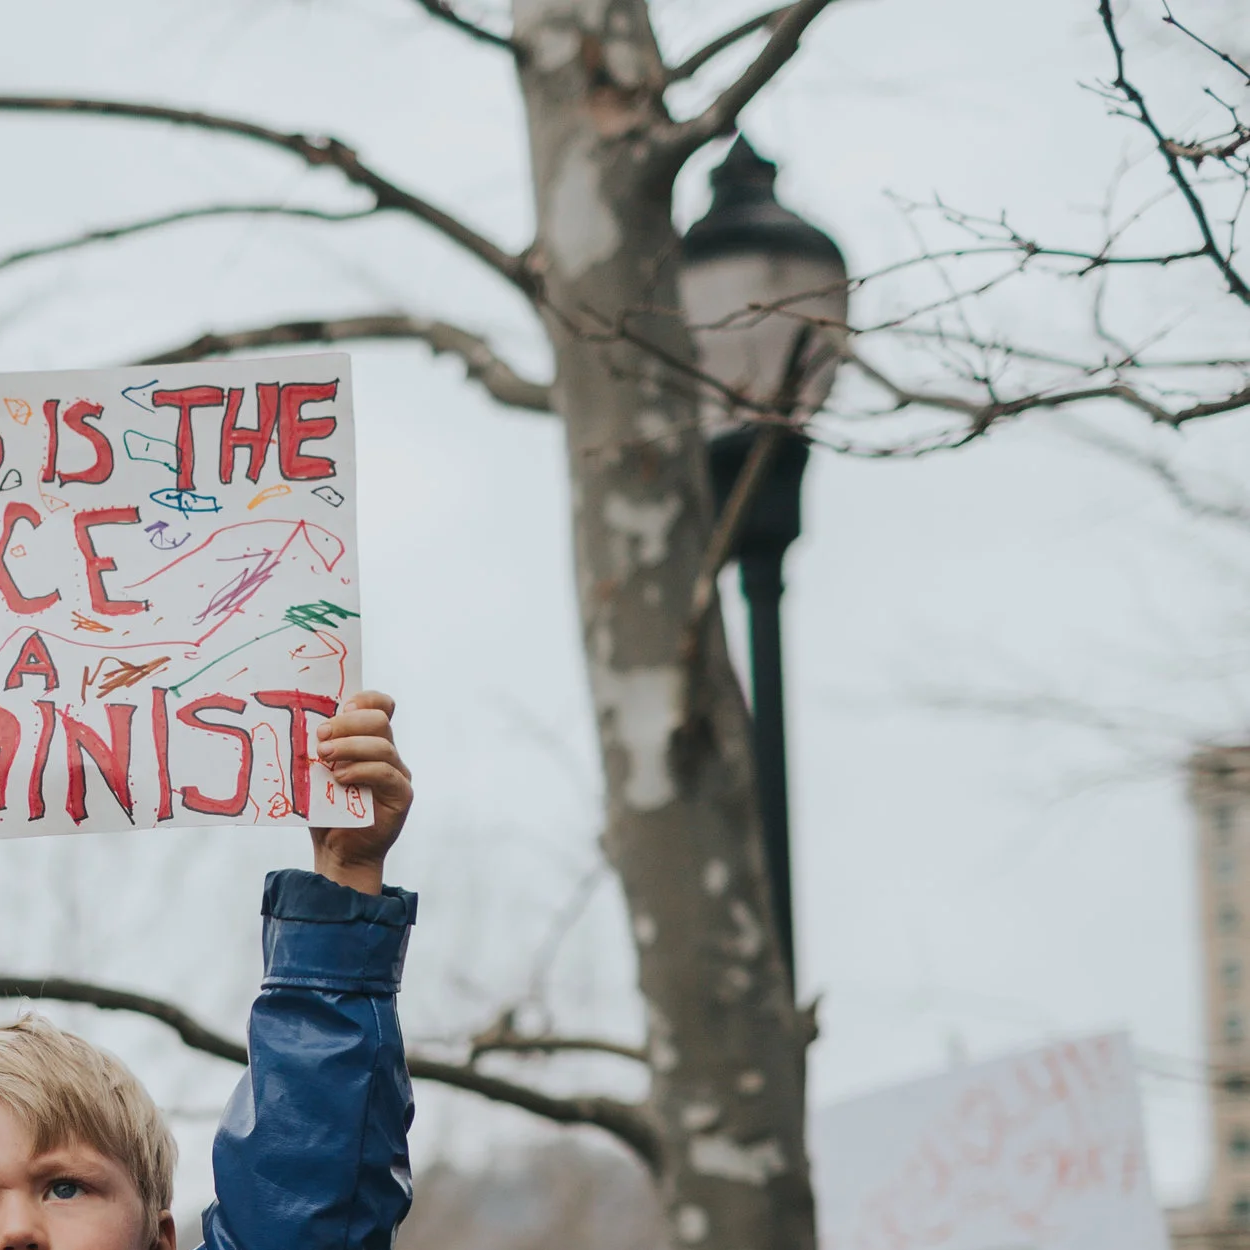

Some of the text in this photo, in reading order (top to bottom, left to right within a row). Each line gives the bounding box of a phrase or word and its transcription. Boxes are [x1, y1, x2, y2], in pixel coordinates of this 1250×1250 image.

[41, 398, 114, 486] IS
[152, 379, 341, 491] THE
[4, 632, 60, 693] A
